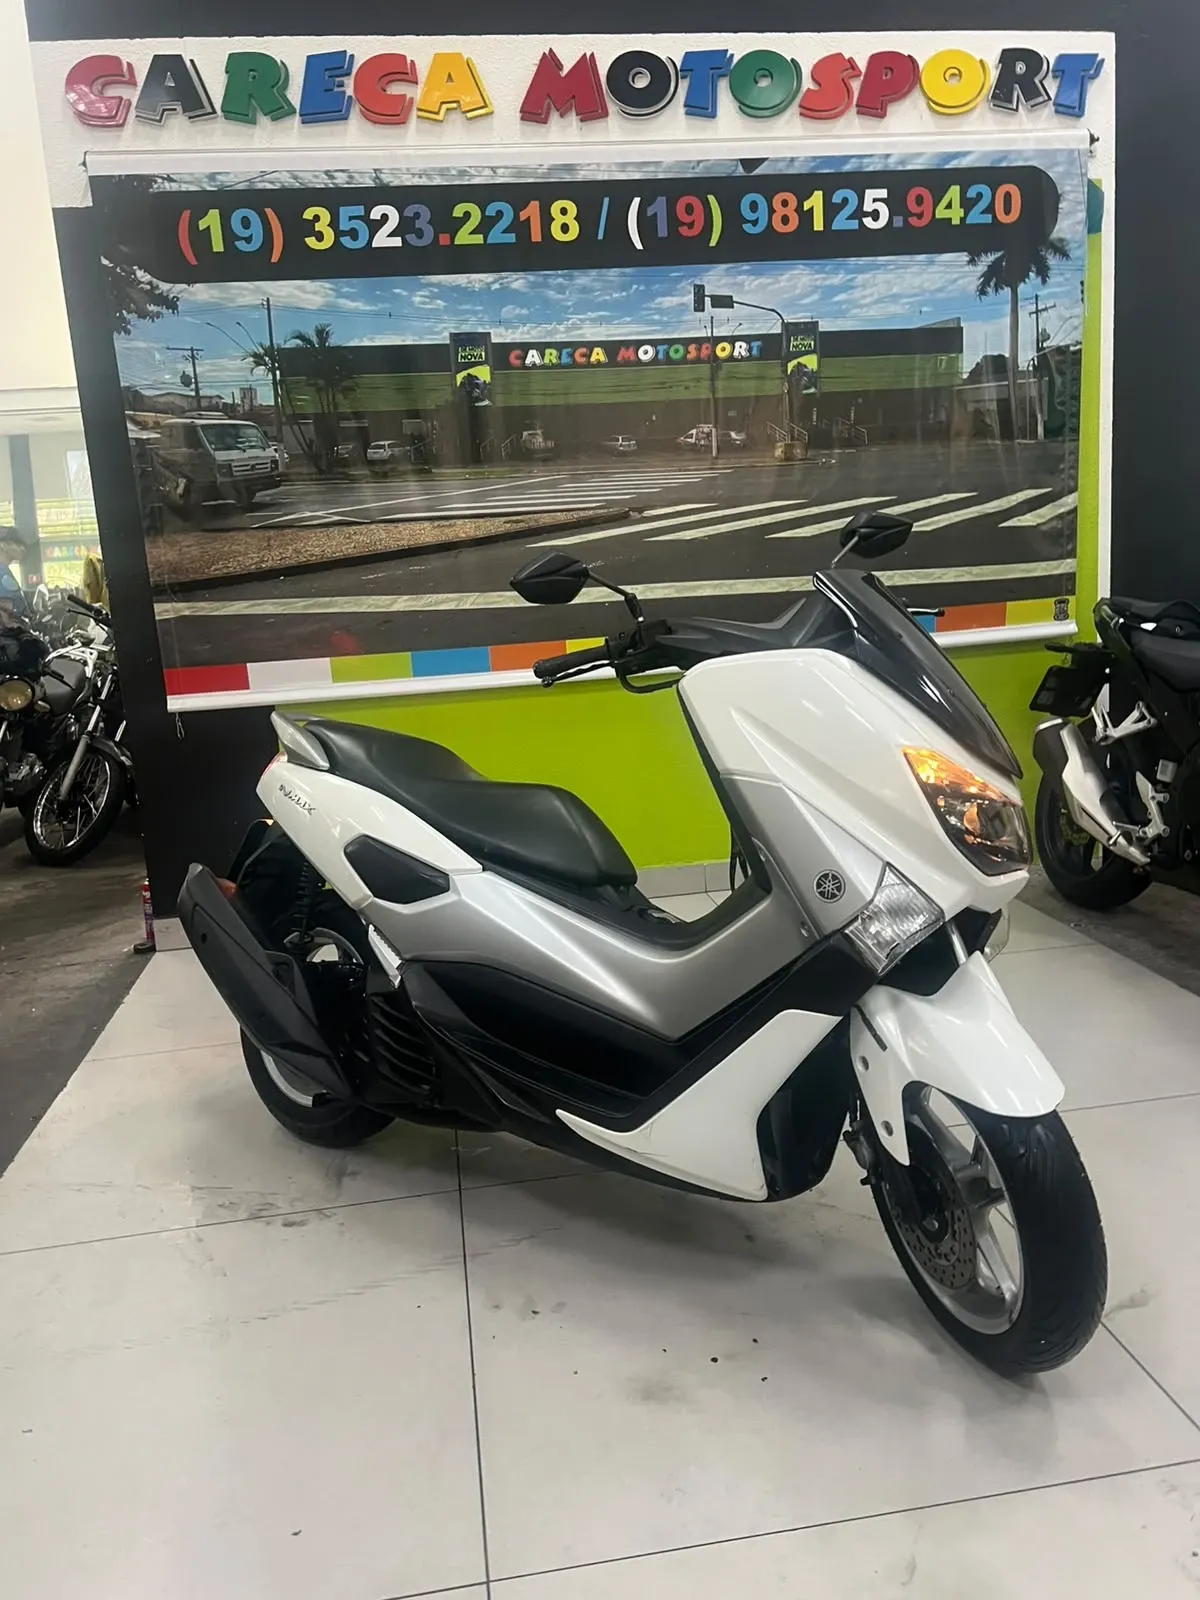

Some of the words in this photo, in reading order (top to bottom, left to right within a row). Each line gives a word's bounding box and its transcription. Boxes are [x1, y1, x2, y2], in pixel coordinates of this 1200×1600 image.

[64, 49, 495, 127] CARECA
[519, 47, 1104, 123] MOTOSPORT
[177, 207, 284, 266] (19)
[302, 199, 580, 250] 3523.2218
[627, 194, 723, 251] (19)
[741, 184, 1022, 236] 98125.9420
[460, 353, 484, 361] NOVA
[508, 347, 608, 367] CARECA
[616, 340, 763, 363] MOTOSPORT
[792, 341, 812, 350] NOVA
